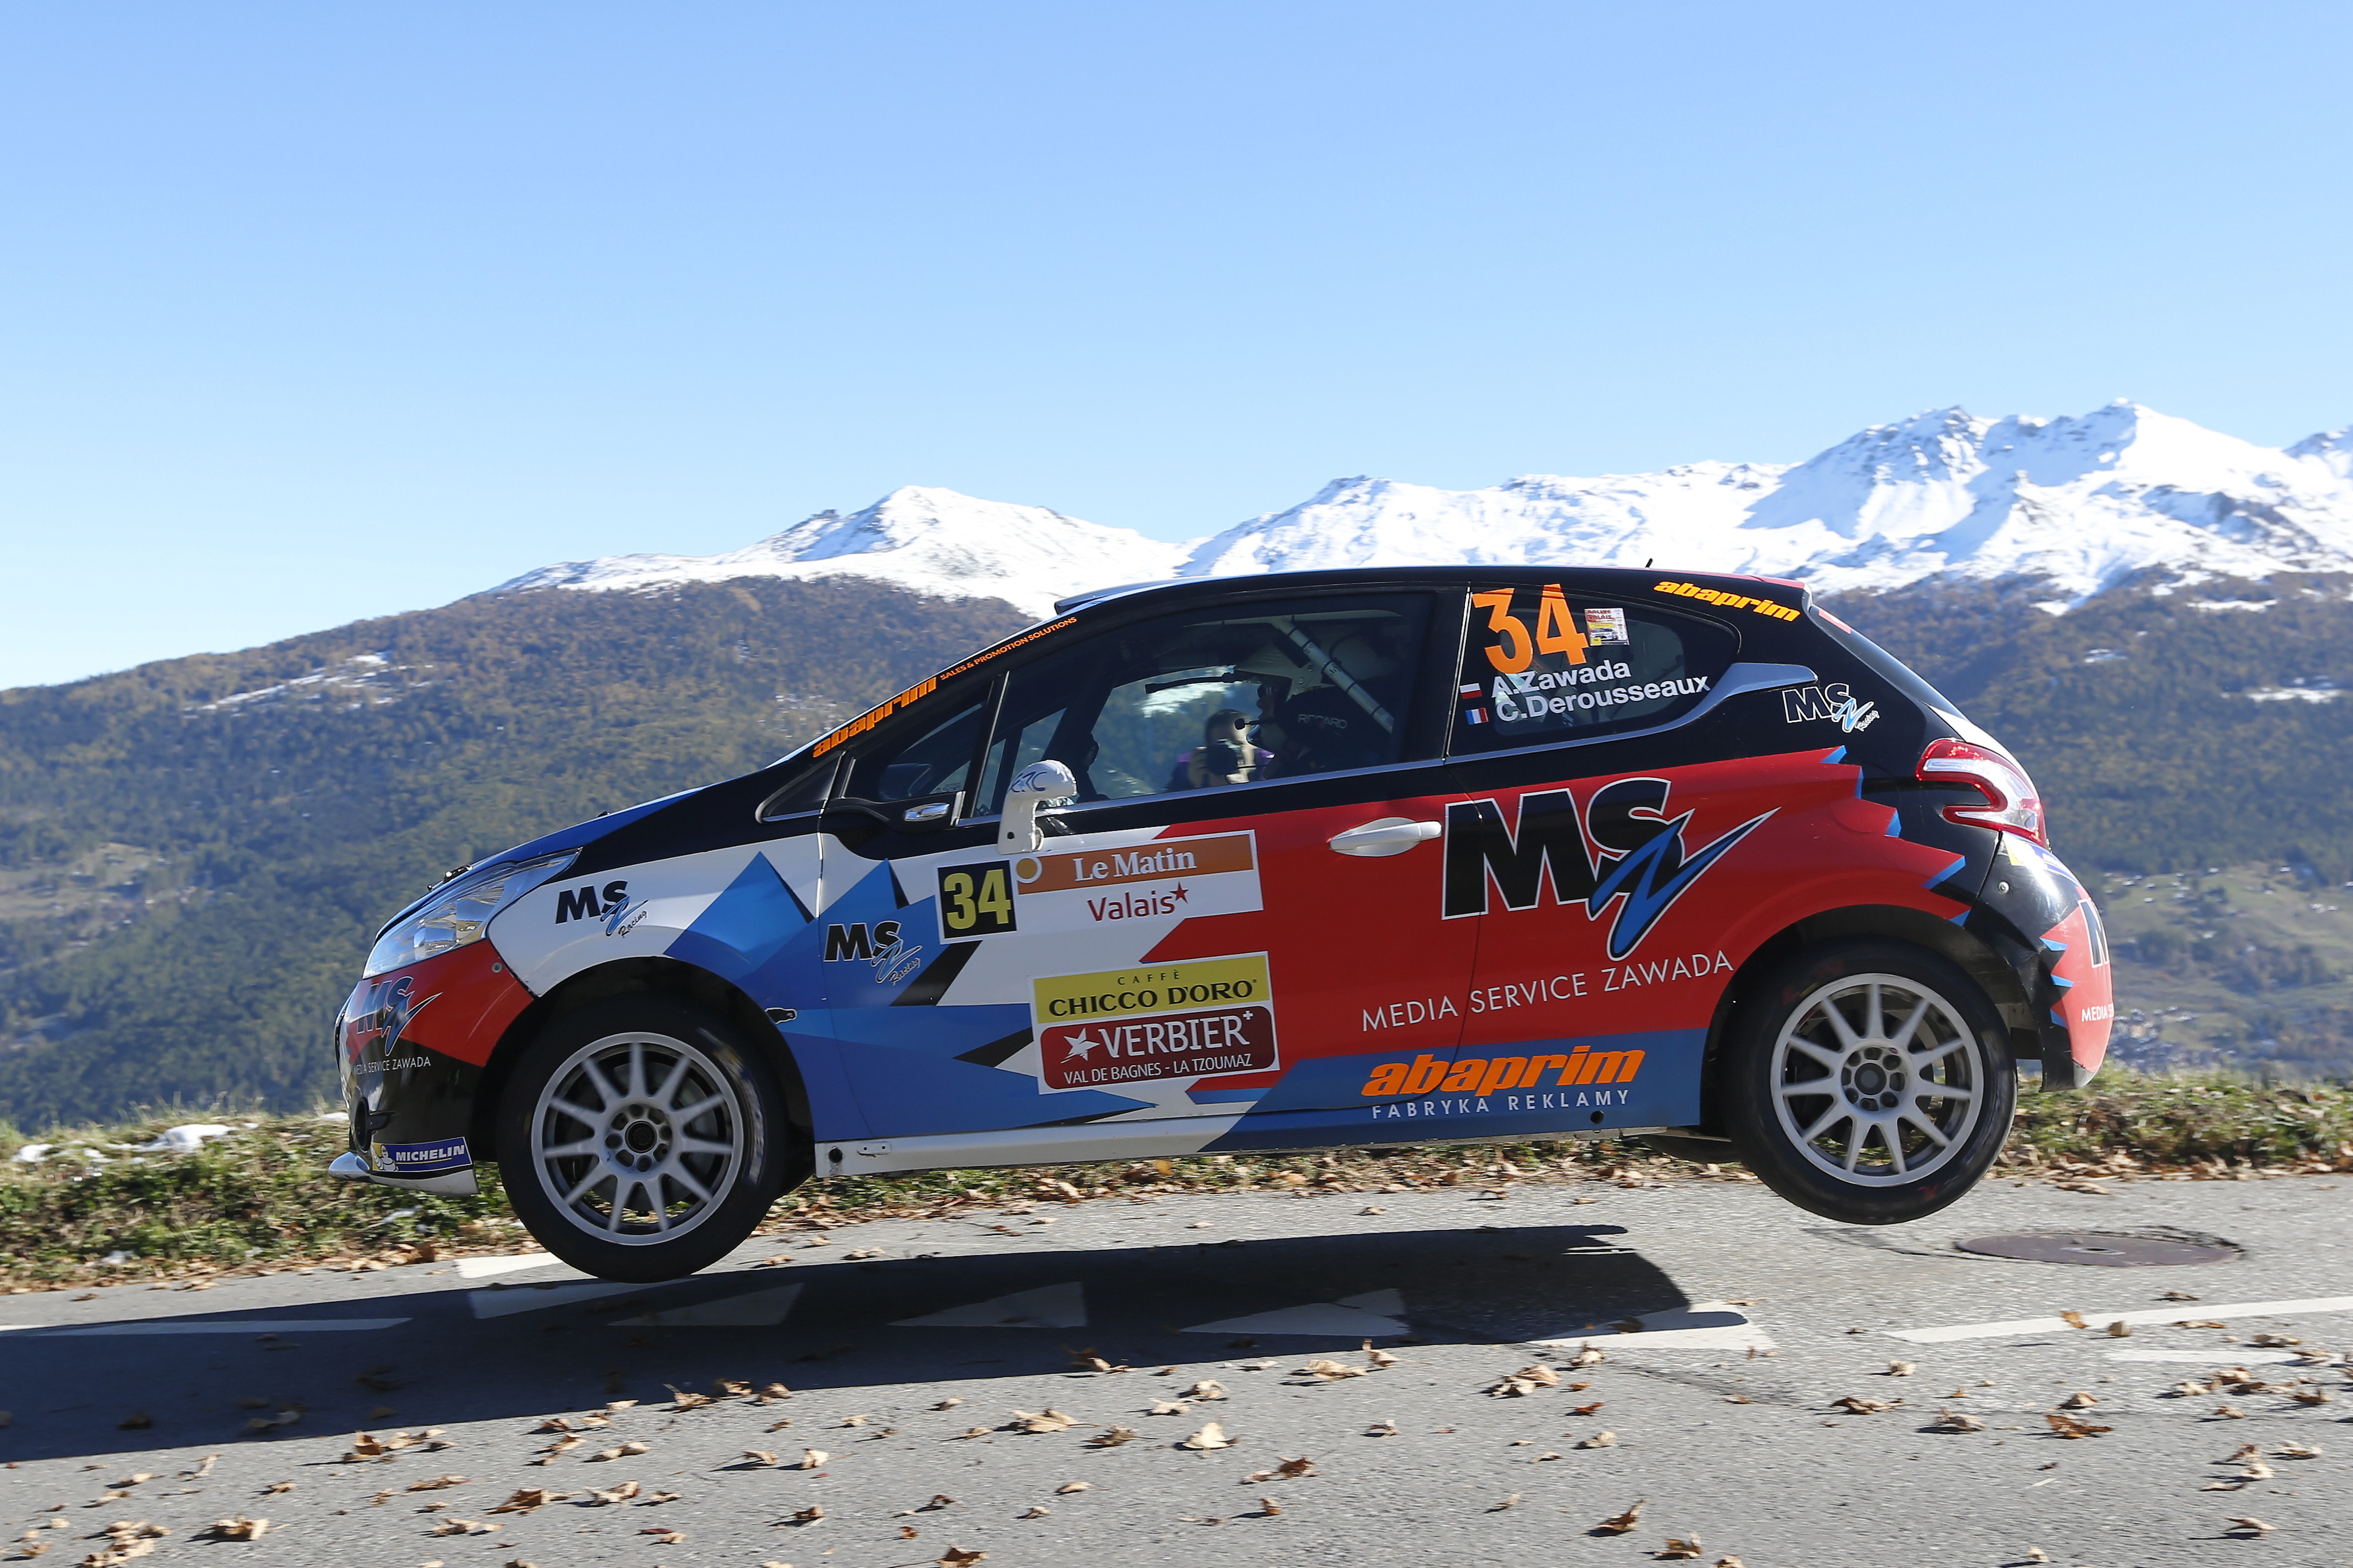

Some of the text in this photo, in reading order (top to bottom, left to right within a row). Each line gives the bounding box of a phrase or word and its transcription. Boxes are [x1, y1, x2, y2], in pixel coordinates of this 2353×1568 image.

[1654, 580, 1801, 622] abaprim
[1472, 583, 1590, 674] 34
[940, 665, 966, 680] SALES
[974, 636, 1028, 666] PROMOTION
[1027, 616, 1077, 642] SOLUTIONS
[1491, 659, 1632, 698] A.Zawada
[813, 677, 937, 758] abaprim
[1495, 676, 1711, 723] C.Derousseaux
[1073, 848, 1197, 882] Le Matin
[944, 869, 1012, 930] 34
[1087, 890, 1176, 922] Valais
[618, 909, 648, 938] Racing
[889, 957, 921, 986] Racing
[1118, 969, 1180, 986] CAFFÈ
[1049, 979, 1253, 1017] CHICCO D'ORO
[1362, 950, 1734, 1032] MEDIA SERVICE ZAWADA
[2082, 1005, 2108, 1022] MEDIA
[1098, 1015, 1250, 1058] VERBIER
[368, 1060, 390, 1073] SERVICE
[392, 1056, 431, 1070] ZAWADA
[1064, 1070, 1089, 1084] VAL
[1092, 1069, 1108, 1081] DE
[1111, 1063, 1161, 1081] BAGNES
[1174, 1060, 1190, 1074] LA
[1192, 1054, 1253, 1071] TZOUMAZ
[1361, 1046, 1646, 1097] abaprim
[1372, 1090, 1630, 1119] FABRYKA REKLAMY
[396, 1144, 465, 1162] MICHELIN
